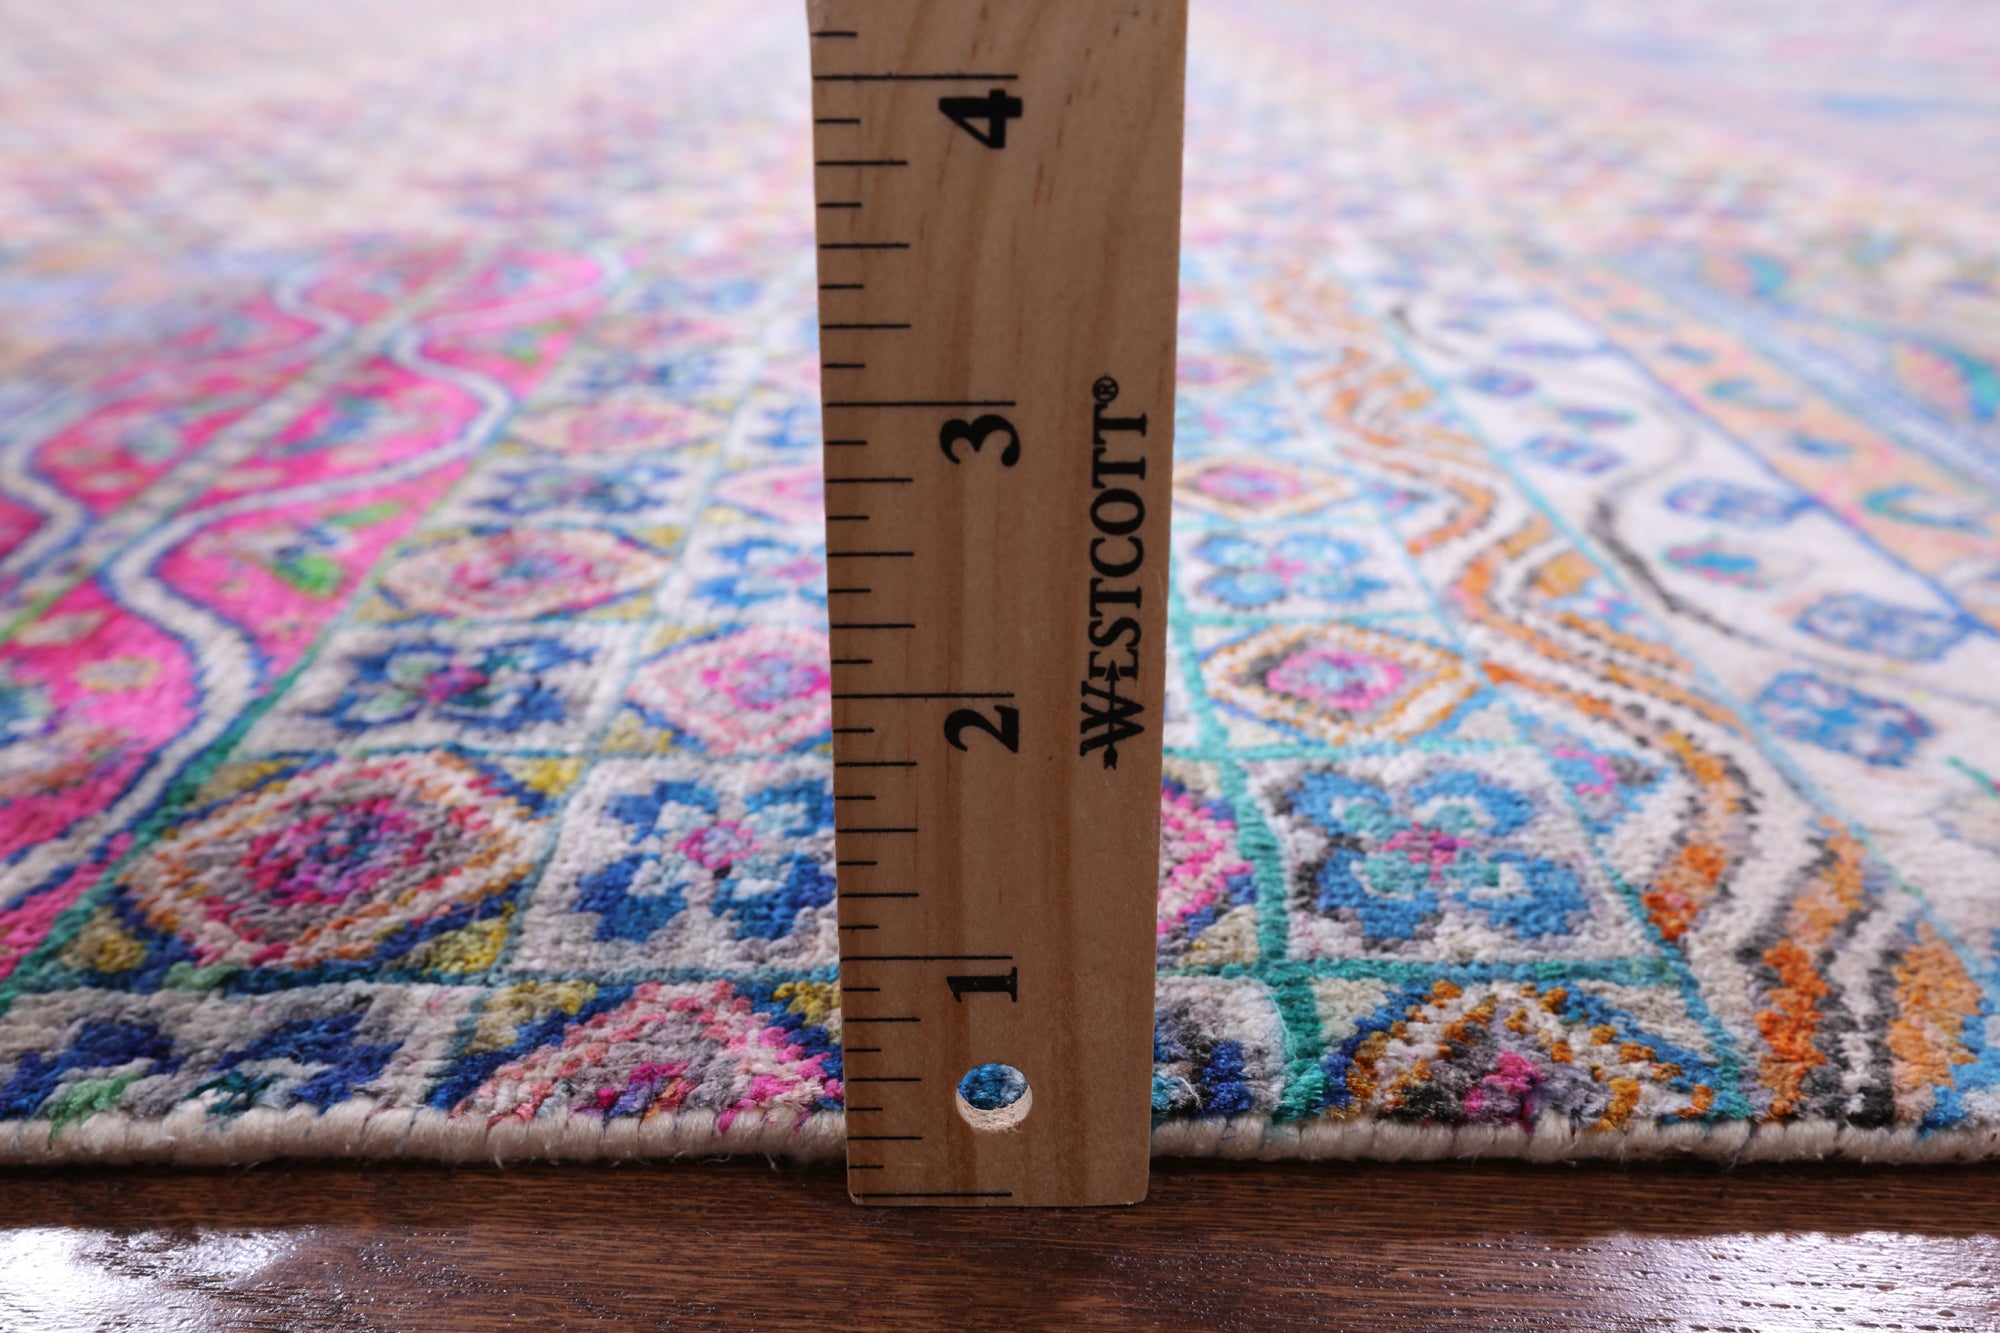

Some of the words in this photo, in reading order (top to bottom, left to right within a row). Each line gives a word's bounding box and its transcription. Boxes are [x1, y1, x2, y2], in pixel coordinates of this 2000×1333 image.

[938, 88, 1024, 150] 4
[939, 413, 1021, 468] 3
[943, 704, 1019, 753] 2
[946, 966, 1018, 1003] 1
